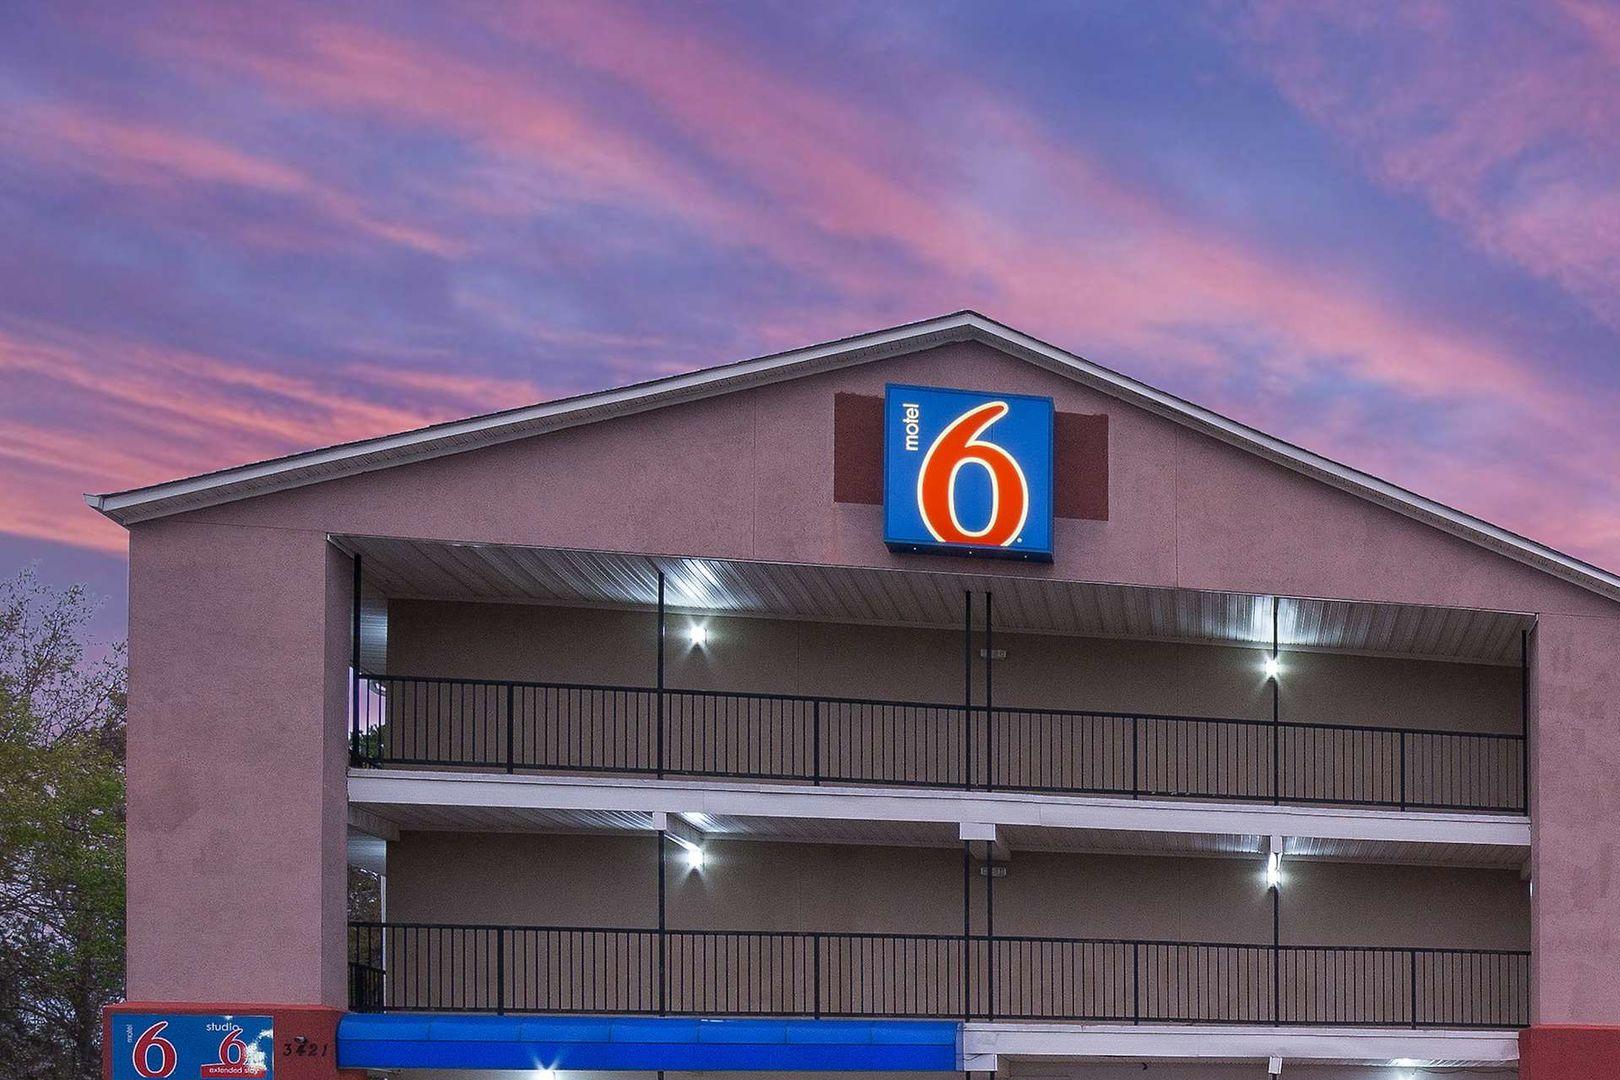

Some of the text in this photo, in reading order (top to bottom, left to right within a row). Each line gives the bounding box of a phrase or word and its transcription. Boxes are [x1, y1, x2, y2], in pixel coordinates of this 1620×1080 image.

[902, 403, 919, 451] motel
[917, 401, 1028, 546] 6
[132, 1021, 177, 1077] 6
[206, 1022, 240, 1032] studio
[219, 1028, 248, 1066] 6
